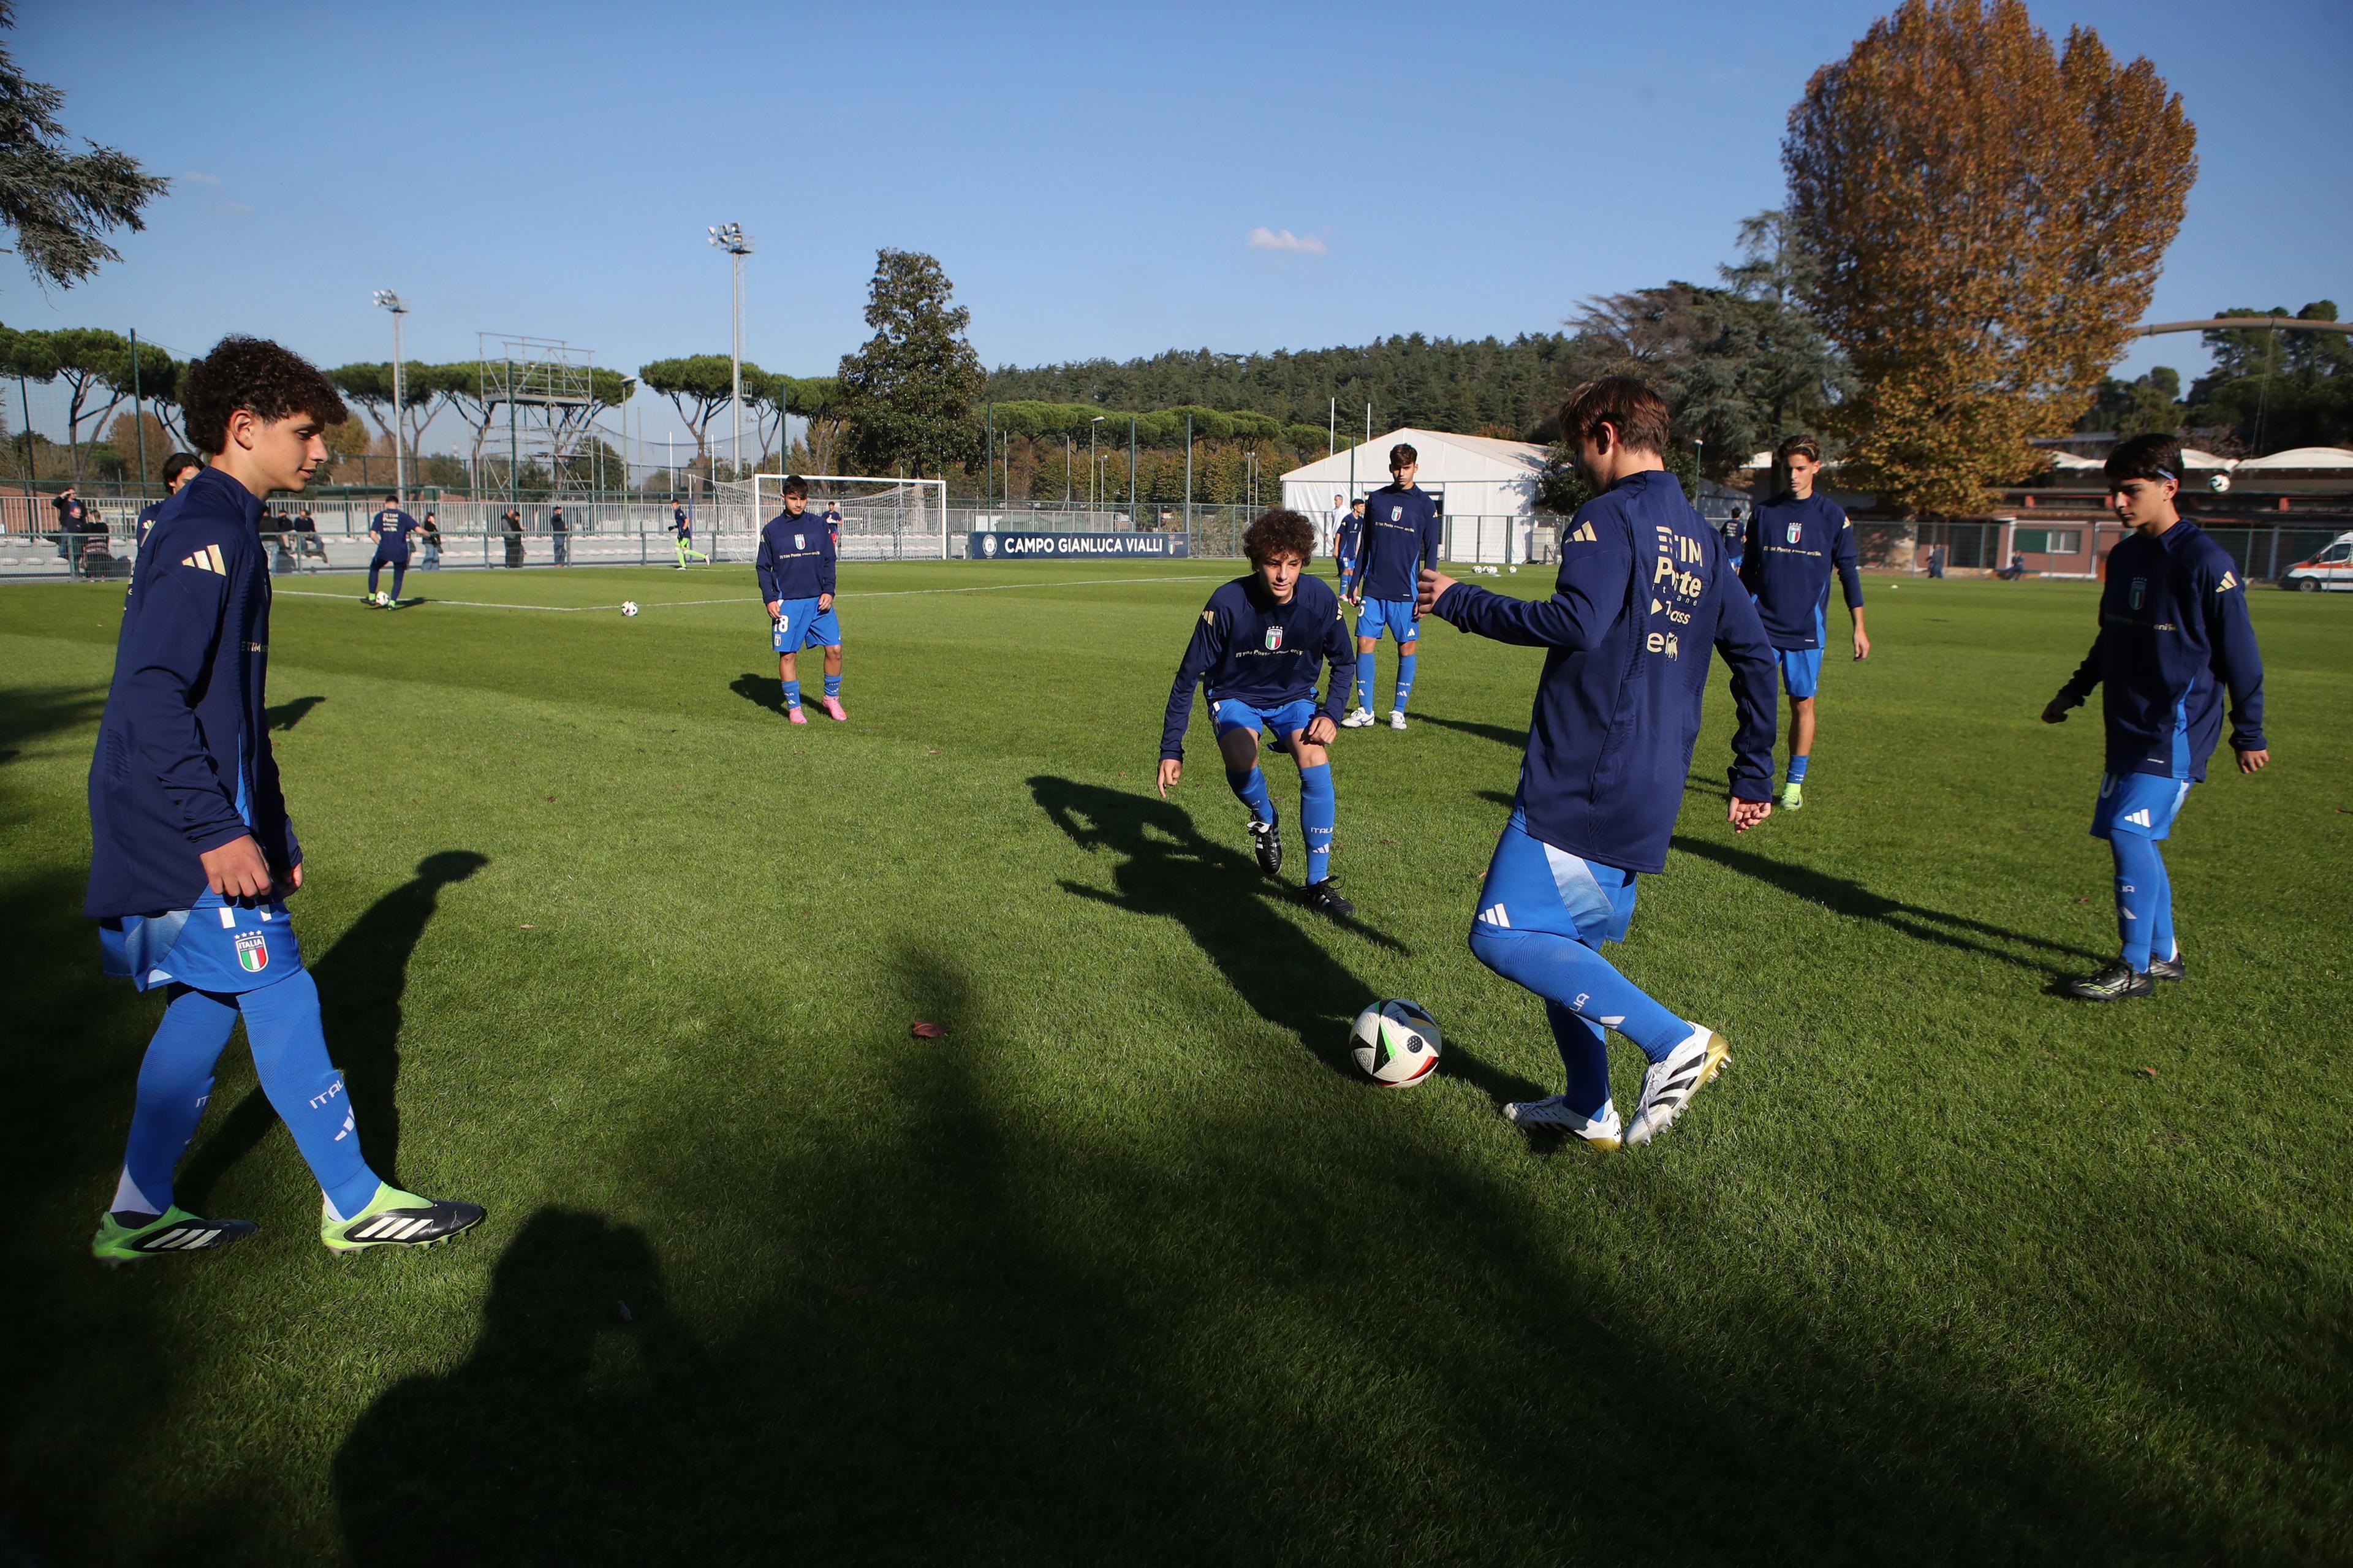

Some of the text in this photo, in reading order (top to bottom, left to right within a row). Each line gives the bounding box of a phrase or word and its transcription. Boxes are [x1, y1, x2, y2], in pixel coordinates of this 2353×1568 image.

[1004, 537, 1055, 553] CAMPO
[1058, 537, 1123, 553] GIANLUCA
[1126, 538, 1163, 552] VIALLI
[238, 939, 263, 949] ITALIA
